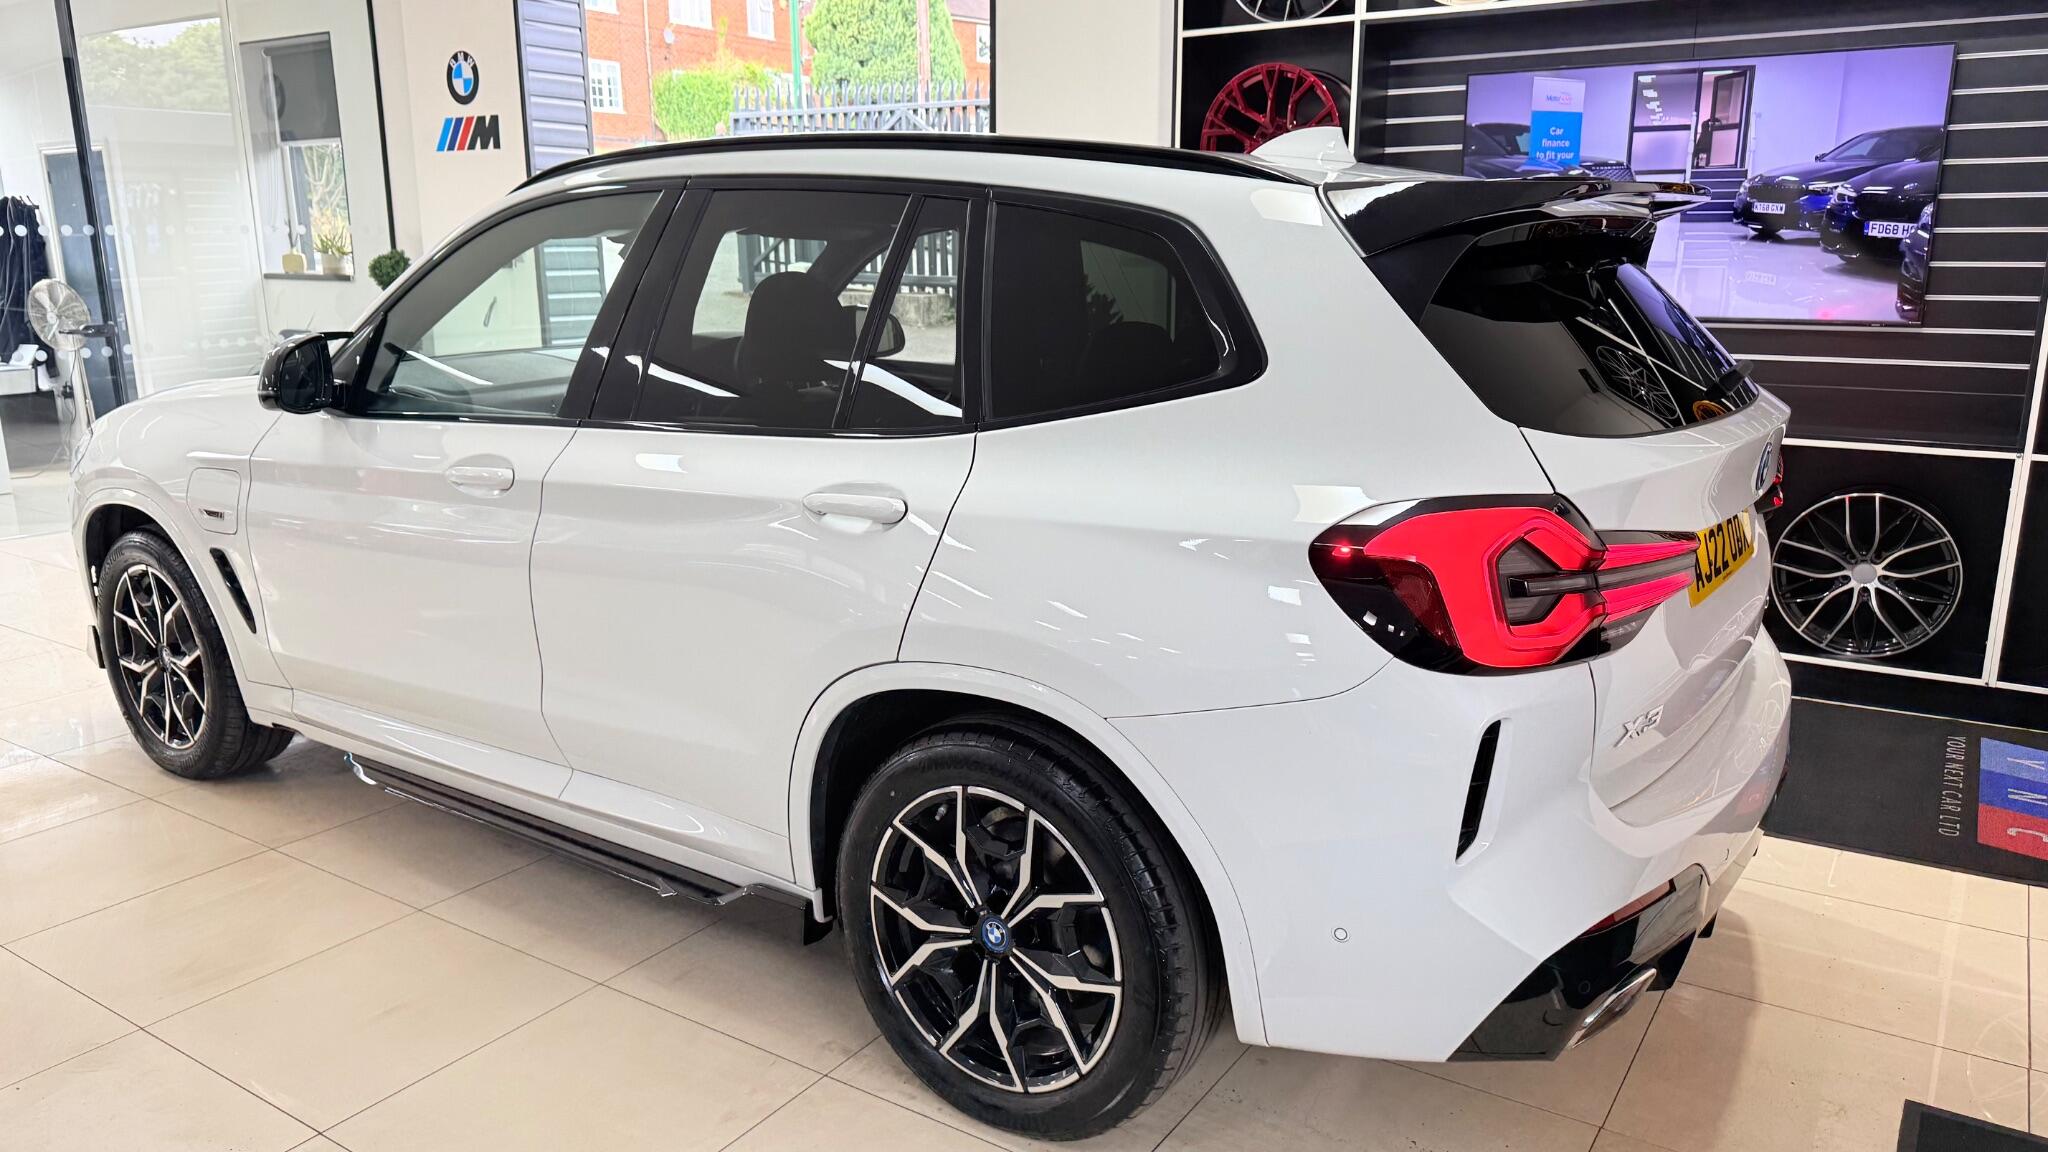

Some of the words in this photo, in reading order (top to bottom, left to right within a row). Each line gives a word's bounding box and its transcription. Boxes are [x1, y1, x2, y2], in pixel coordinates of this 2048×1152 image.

[1549, 127, 1564, 136] Car
[1542, 138, 1570, 148] finance
[1536, 151, 1545, 160] to
[1545, 151, 1556, 160] fit
[1557, 152, 1574, 161] your
[1870, 222, 1899, 236] FD68
[1694, 523, 1730, 592] AJ22
[1613, 703, 1664, 748] X3
[1945, 735, 1966, 760] YOUR
[1942, 762, 1964, 789] NEXT
[1940, 790, 1963, 812] CAR
[1938, 815, 1961, 837] LTD
